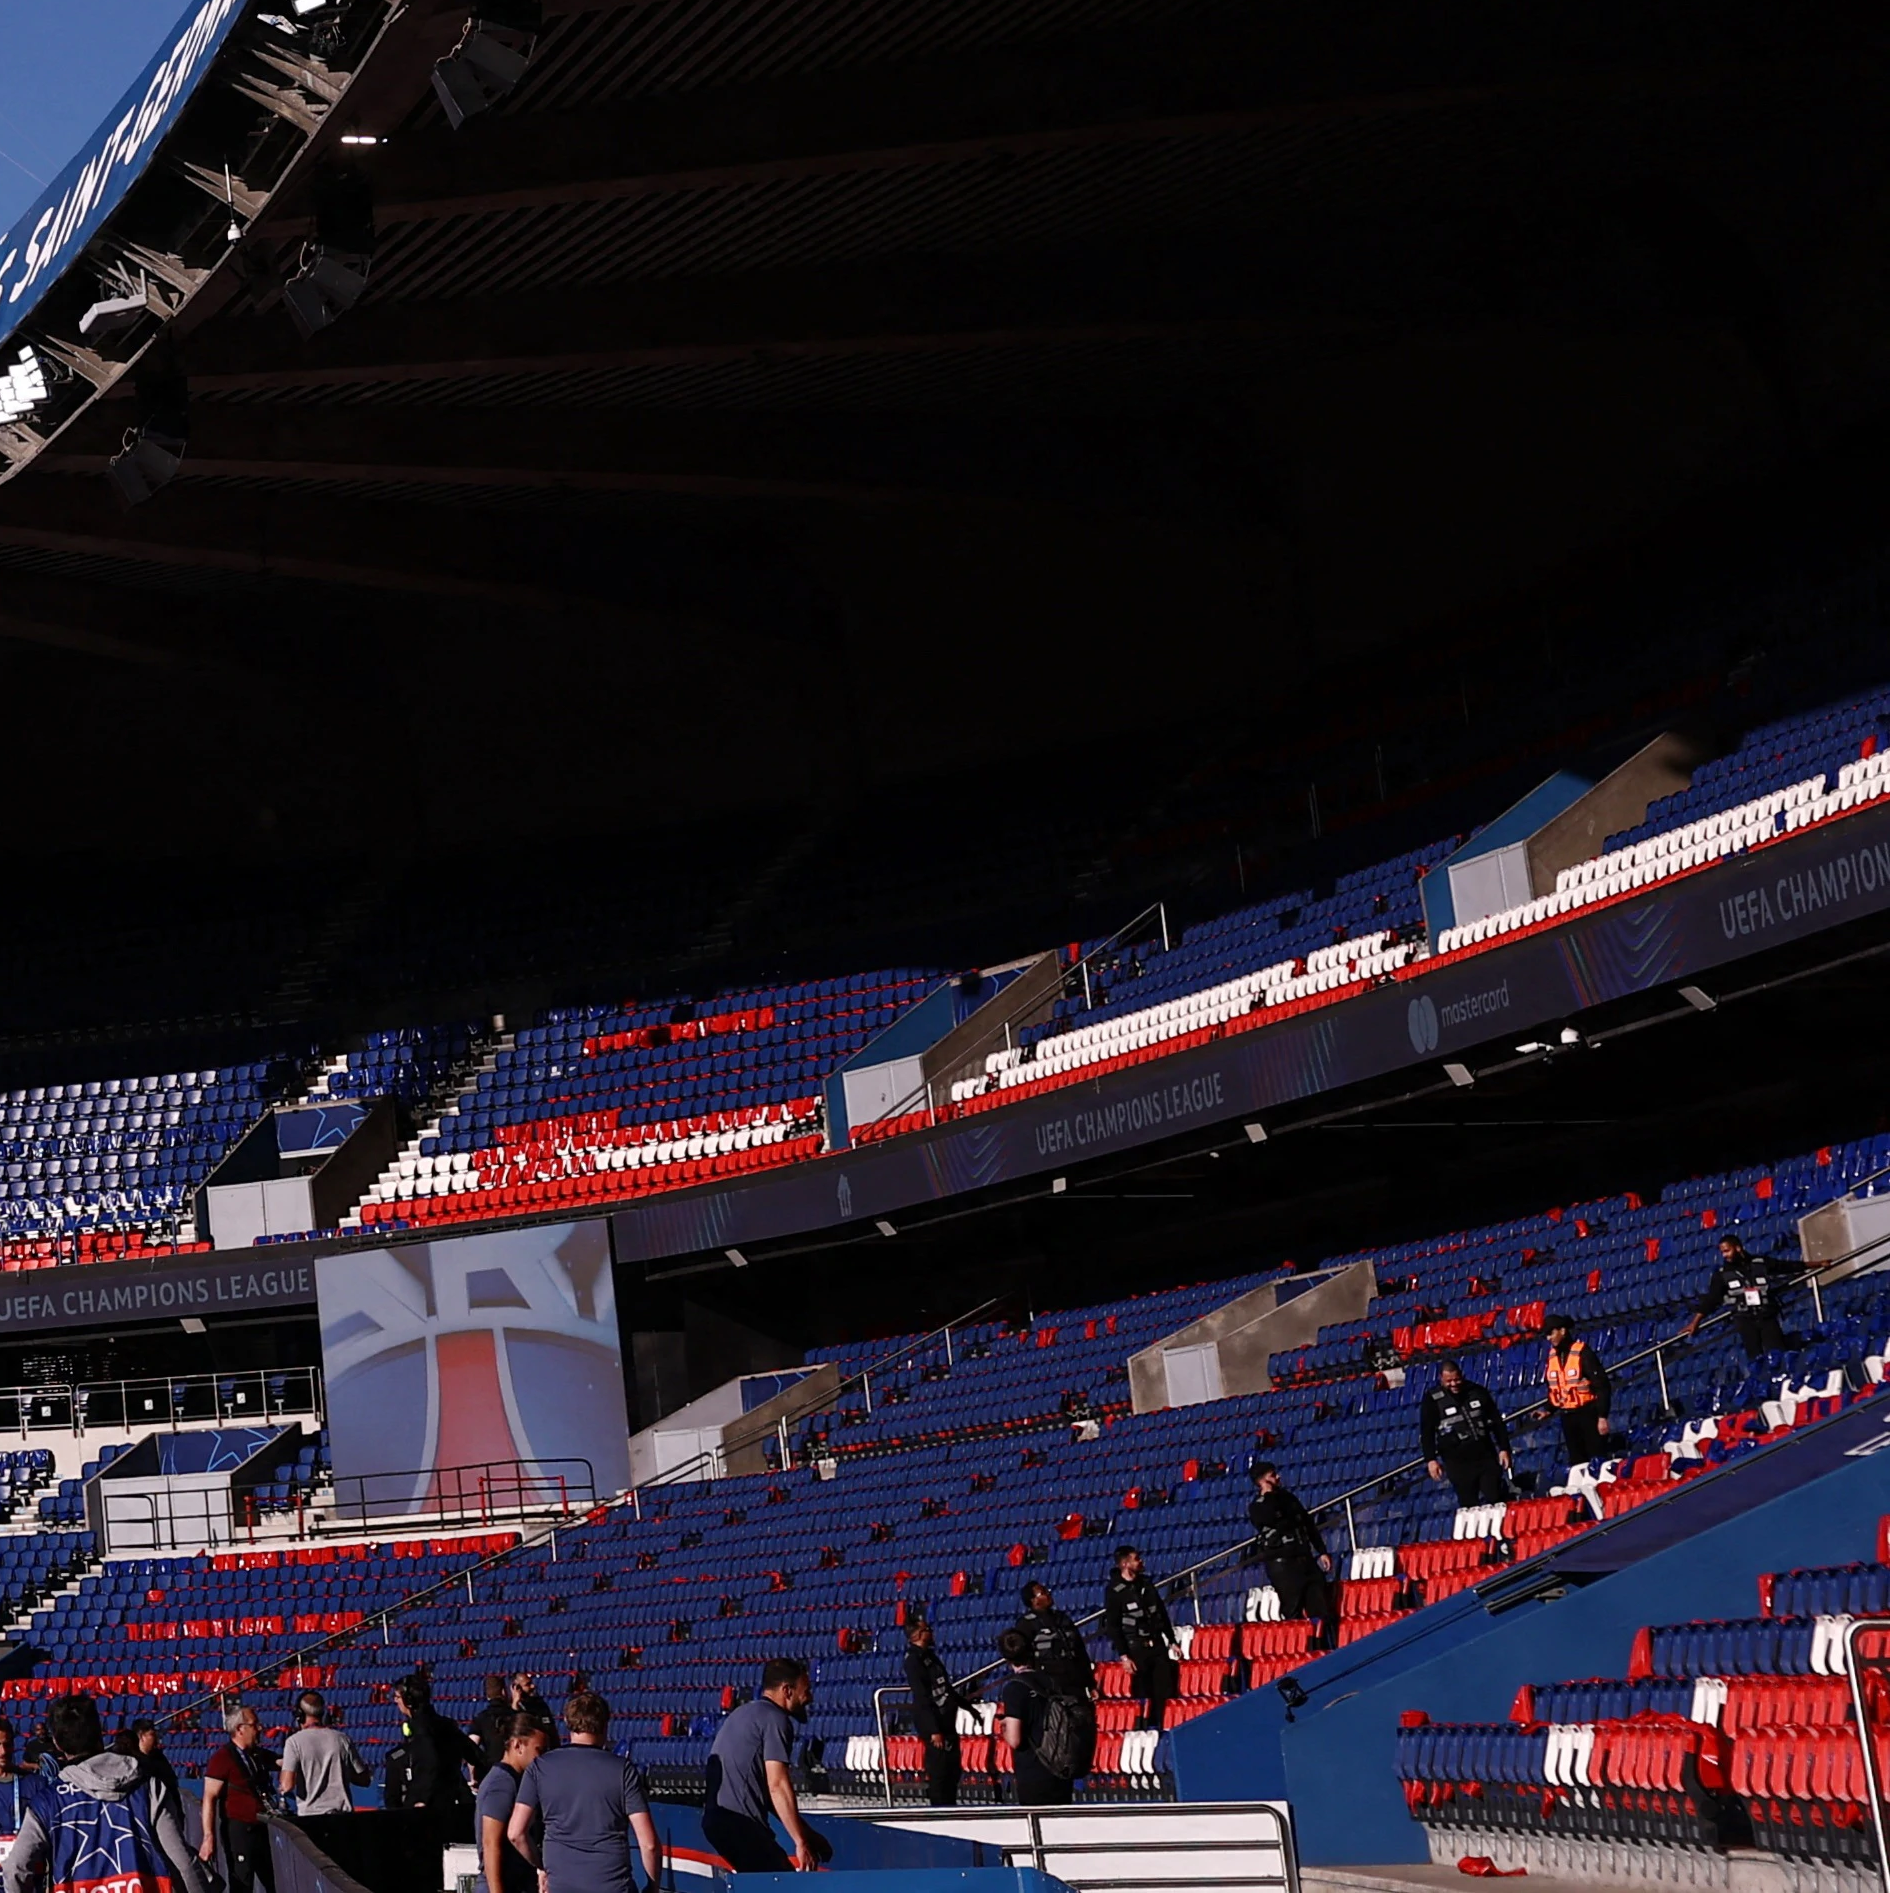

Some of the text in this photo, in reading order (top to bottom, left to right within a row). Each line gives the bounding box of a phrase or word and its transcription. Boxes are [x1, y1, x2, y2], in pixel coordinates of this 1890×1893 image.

[1719, 886, 1775, 940] UEFA
[1441, 978, 1510, 1028] mastercard
[1035, 1071, 1224, 1155] UEFA CHAMPIONS LEAGUE
[63, 1278, 209, 1316] CHAMPIONS
[215, 1267, 310, 1301] LEAGUE
